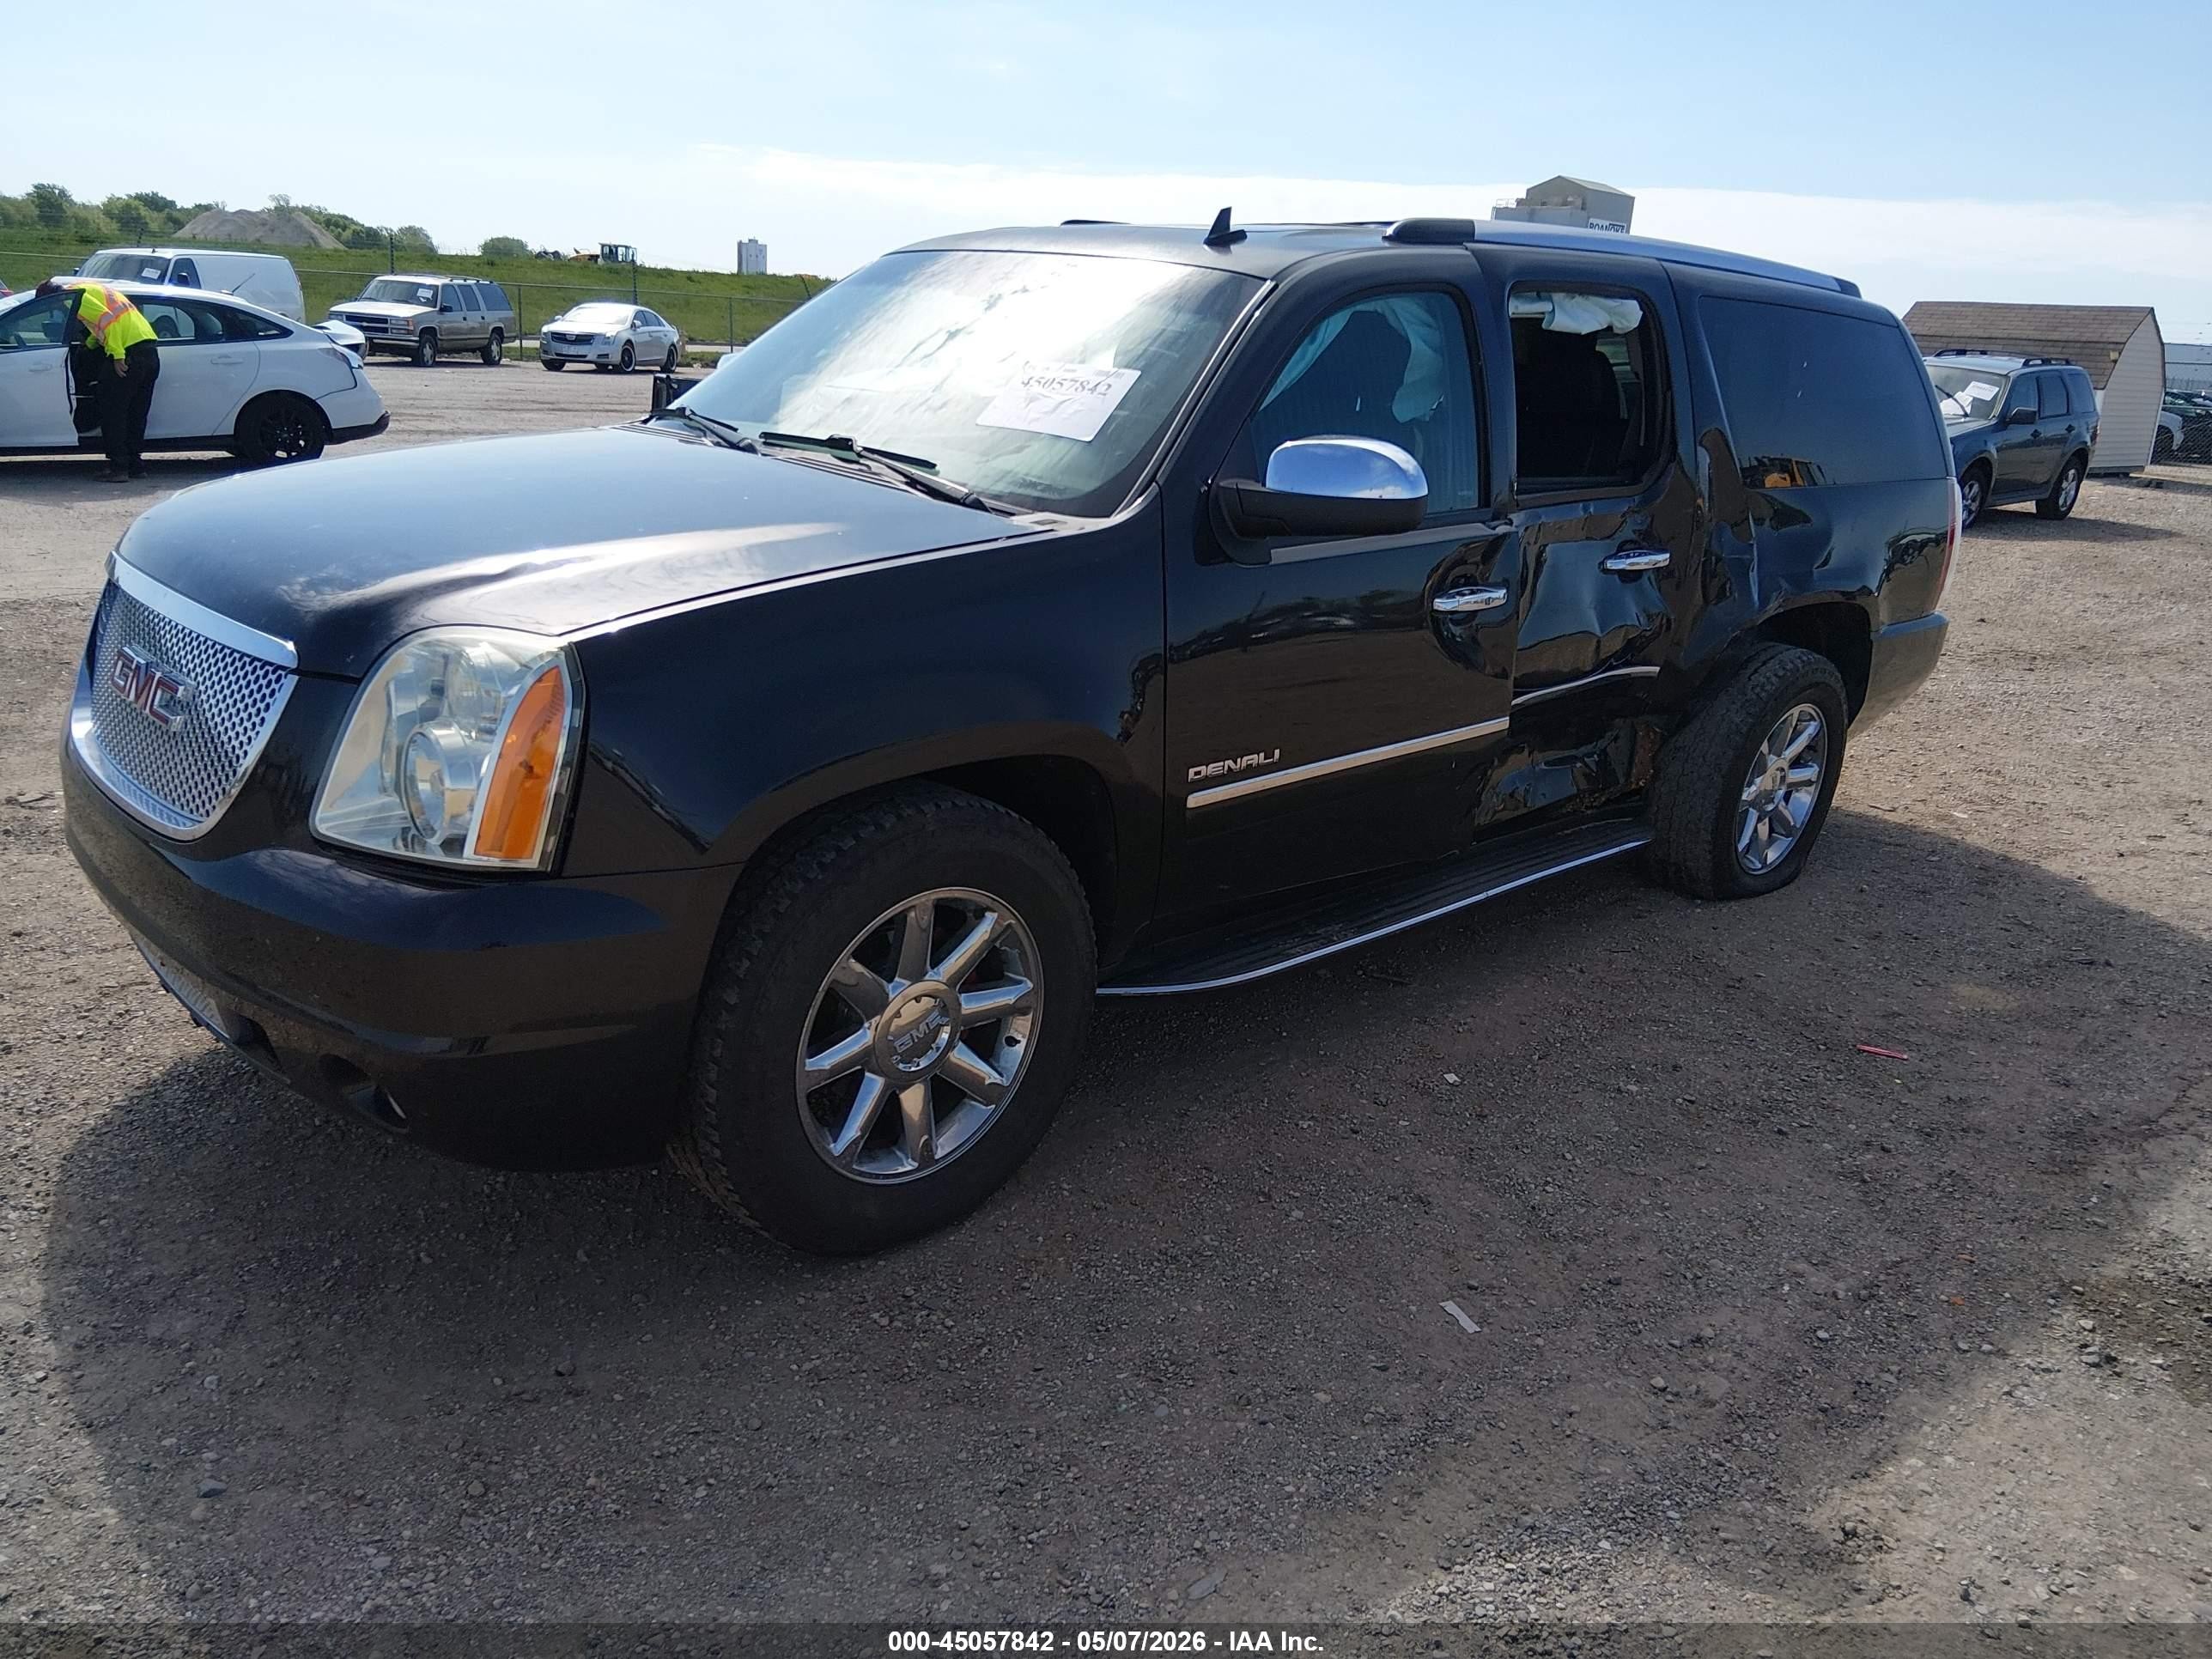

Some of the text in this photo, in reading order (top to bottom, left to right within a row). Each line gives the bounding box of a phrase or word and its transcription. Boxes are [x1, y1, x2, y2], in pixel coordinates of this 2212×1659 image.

[1021, 376, 1113, 397] 45057842
[110, 646, 186, 728] GMC
[1188, 748, 1280, 783] DENALI
[893, 1009, 950, 1054] GMC
